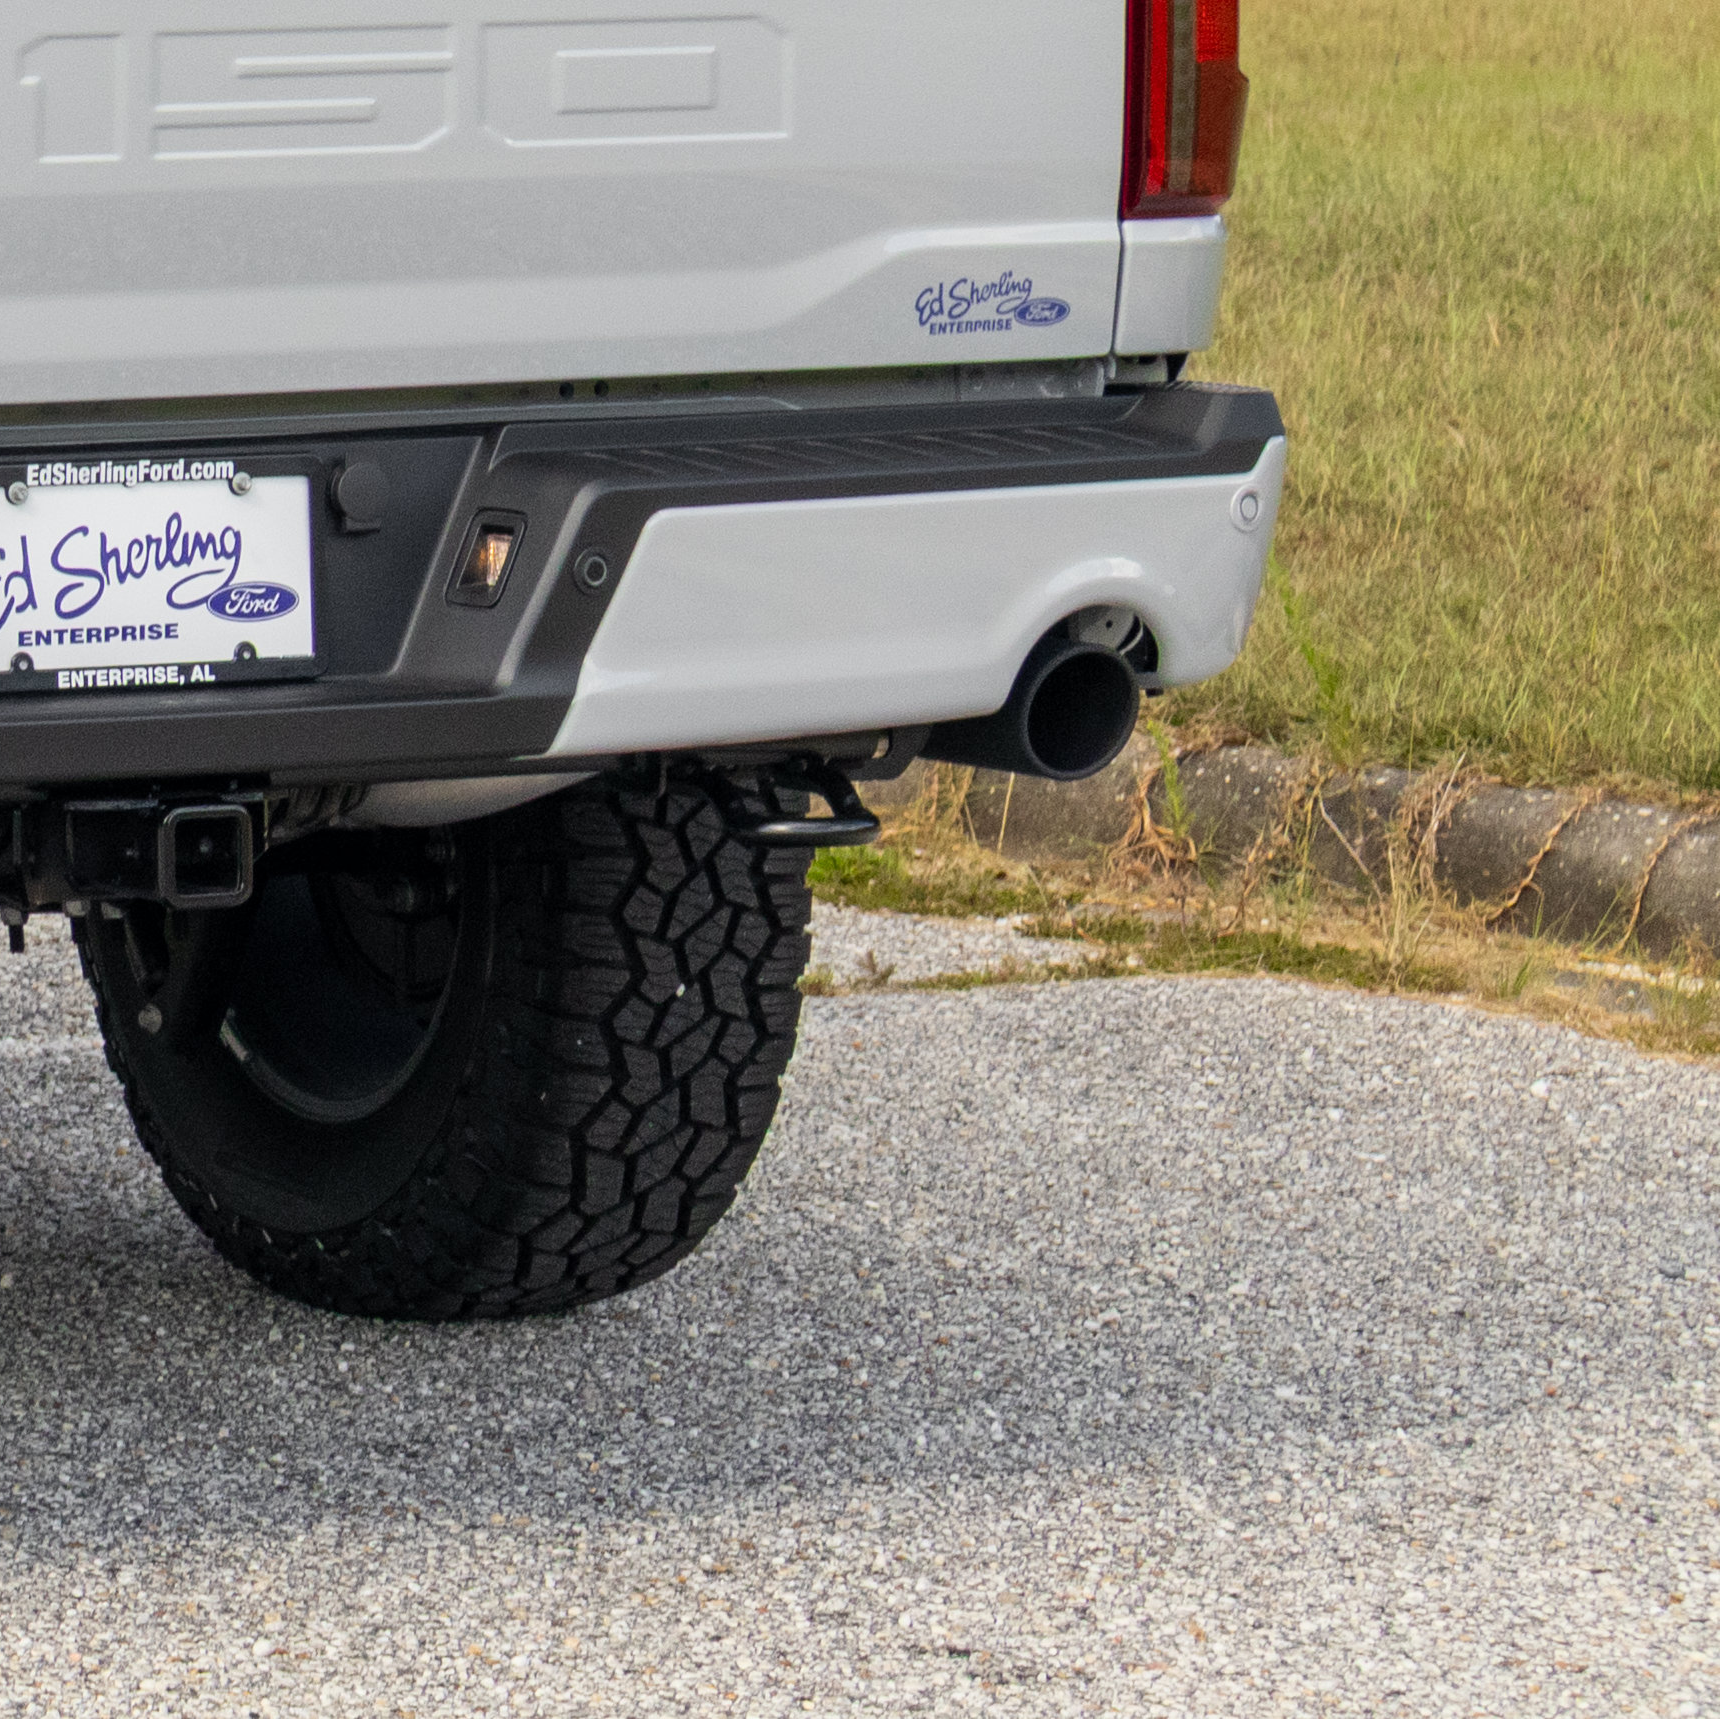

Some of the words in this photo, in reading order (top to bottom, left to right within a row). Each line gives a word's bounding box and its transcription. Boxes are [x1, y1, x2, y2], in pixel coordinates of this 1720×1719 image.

[915, 282, 944, 326] Ed
[948, 270, 1033, 319] Sherling
[929, 318, 1012, 335] ENTERPRISE
[27, 459, 234, 488] EdSherlingFord.com
[51, 512, 242, 620] Sherling
[18, 623, 179, 647] ENTERPRISE
[58, 667, 185, 691] ENTERPRISE,
[189, 664, 216, 683] AL
